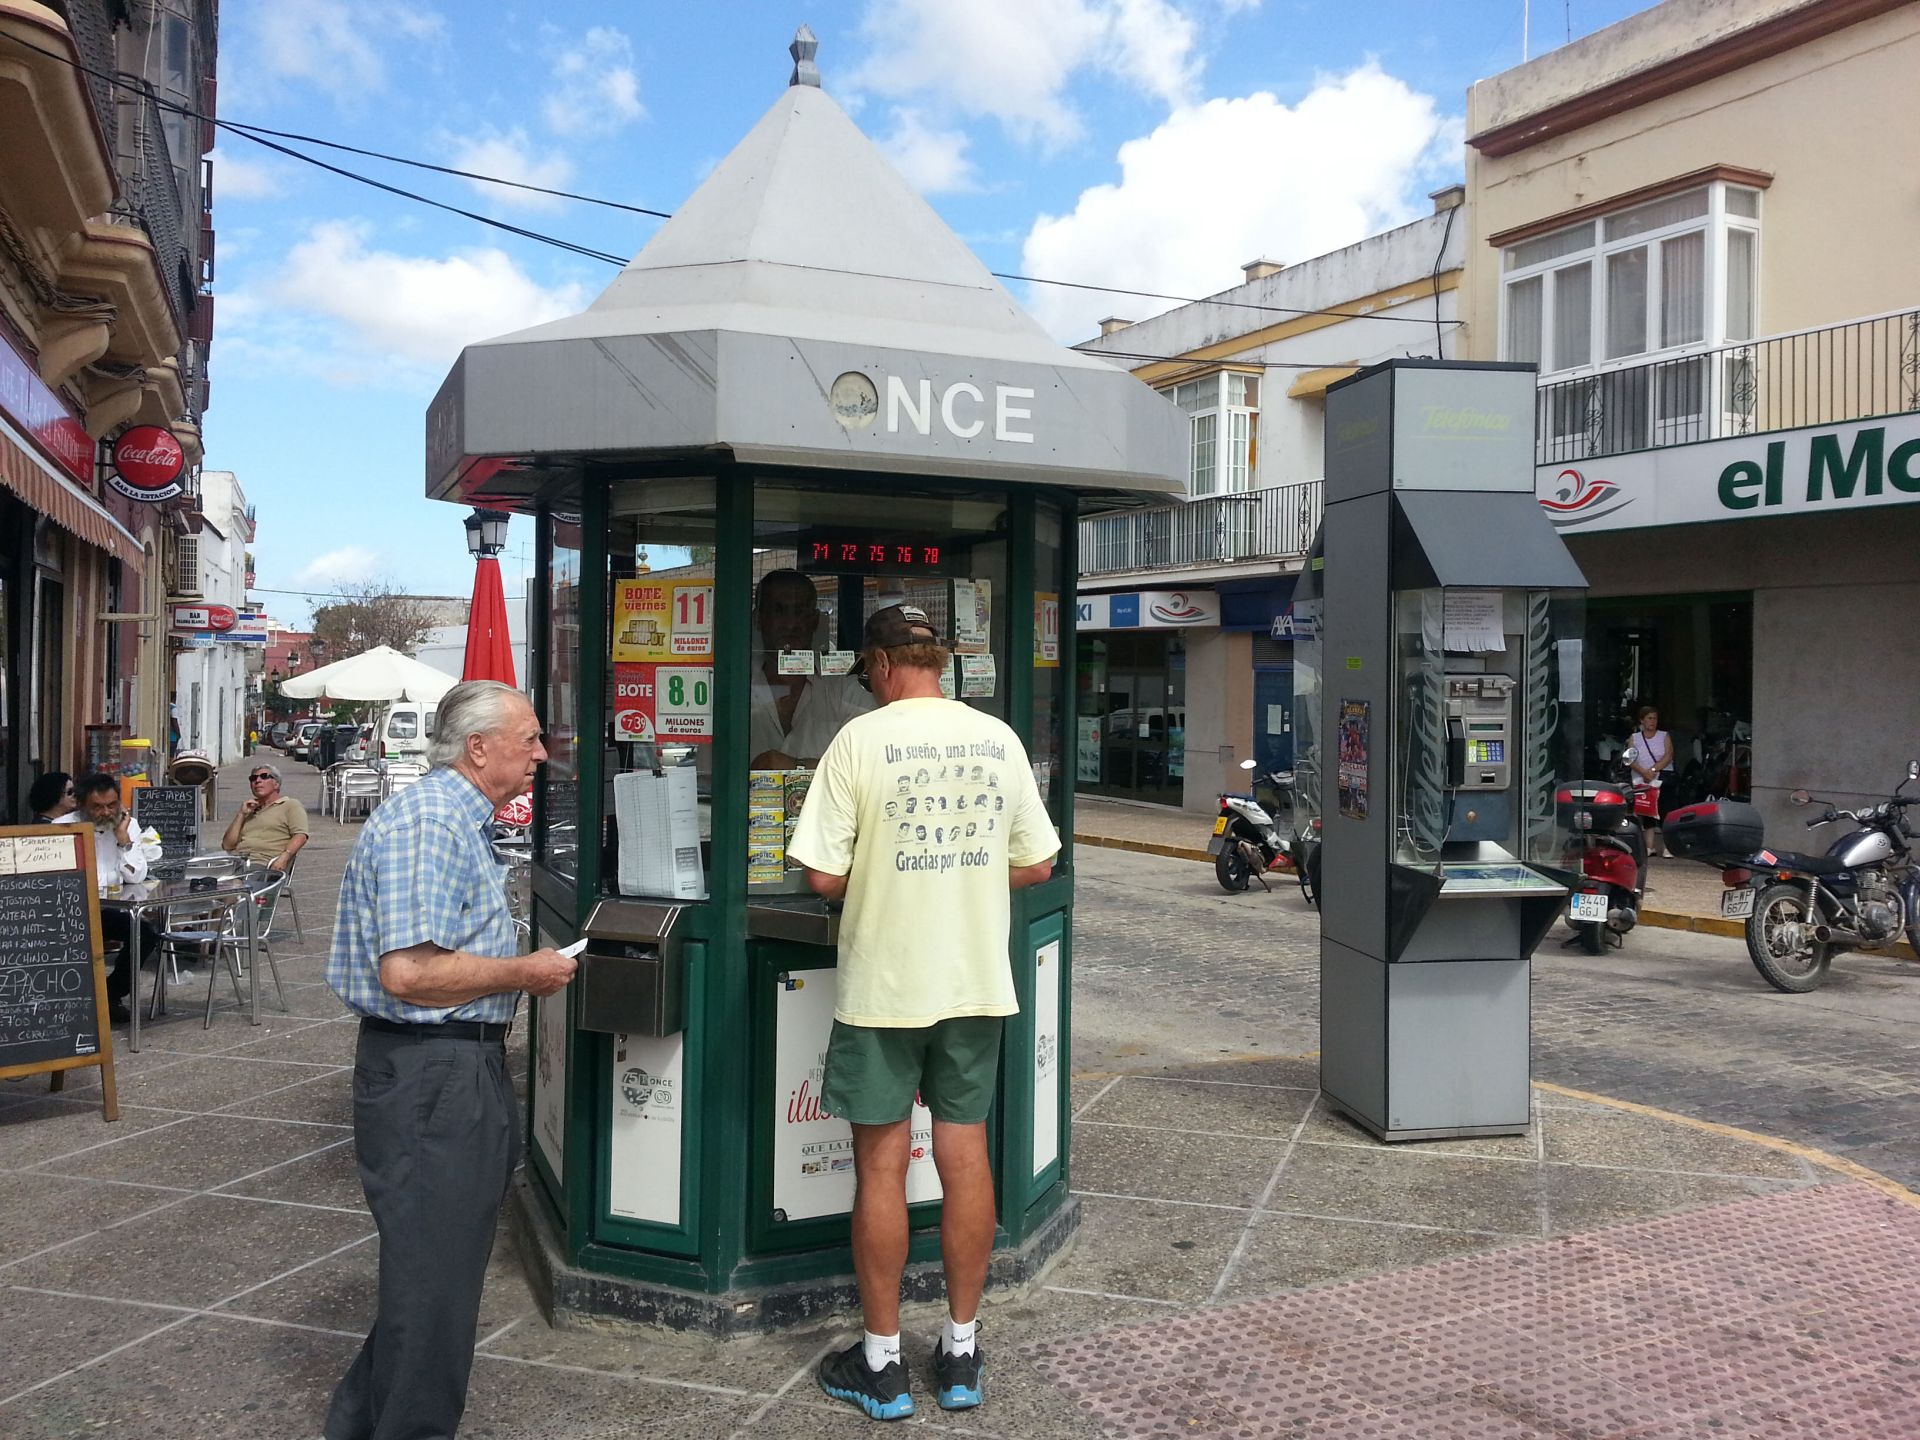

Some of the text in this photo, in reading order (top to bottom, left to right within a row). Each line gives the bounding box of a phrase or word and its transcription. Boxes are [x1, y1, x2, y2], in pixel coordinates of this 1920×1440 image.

[118, 444, 181, 466] Coca-Cola
[1718, 440, 1785, 510] el
[115, 480, 176, 499] BAR LA ESTACION
[813, 543, 939, 564] 71 72 75 76 78
[625, 587, 662, 600] BOTE
[624, 601, 667, 610] viernes
[676, 592, 705, 625] 11
[1271, 615, 1294, 635] AXA
[618, 684, 653, 697] BOTE
[668, 675, 708, 707] 8,0
[665, 718, 705, 726] MILLONES
[885, 740, 1005, 764] Un sueño, una realidad
[896, 847, 989, 874] Gracias por todo
[1579, 895, 1606, 906] 3440
[1726, 902, 1749, 914] 6677
[1579, 907, 1599, 917] GGJ
[649, 1078, 672, 1087] ONCE
[802, 1143, 825, 1156] QUE
[829, 1142, 843, 1151] LA
